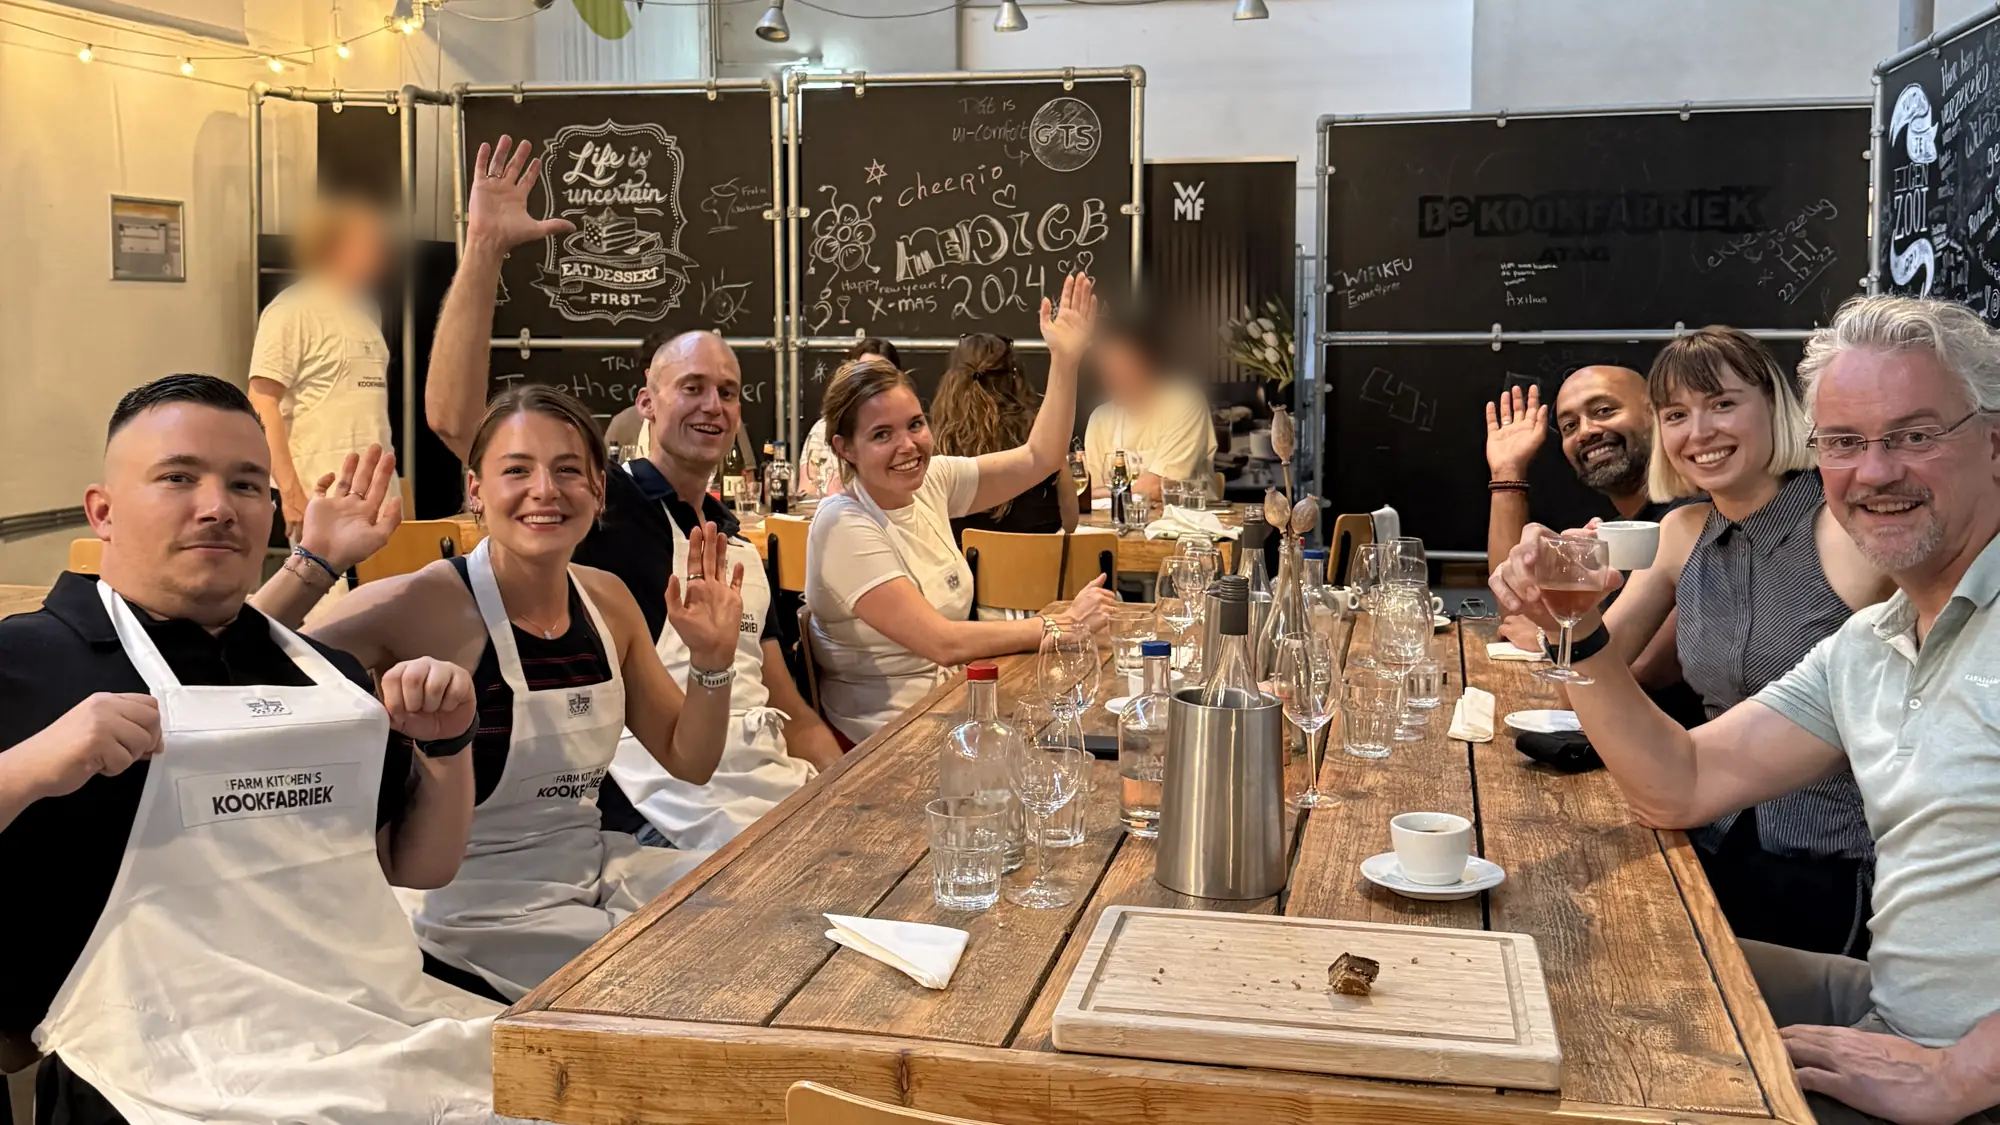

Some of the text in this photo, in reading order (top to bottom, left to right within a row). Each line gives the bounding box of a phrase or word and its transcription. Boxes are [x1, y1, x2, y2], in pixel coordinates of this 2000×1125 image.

[1034, 124, 1095, 151] GTS
[563, 140, 652, 187] Life is
[1894, 161, 1929, 192] EIGEN
[562, 168, 668, 205] uncertain
[1173, 181, 1205, 221] WMF
[1476, 188, 1764, 236] KOOKFABRIEK
[561, 263, 660, 284] EAT DESSERT
[841, 279, 880, 295] Happy
[590, 292, 642, 306] FIRST
[948, 264, 1046, 320] 2024
[230, 777, 264, 791] FARM
[266, 771, 322, 788] KITCHEN'S
[556, 774, 580, 784] FARM
[212, 785, 334, 815] KOOKFABRIEK
